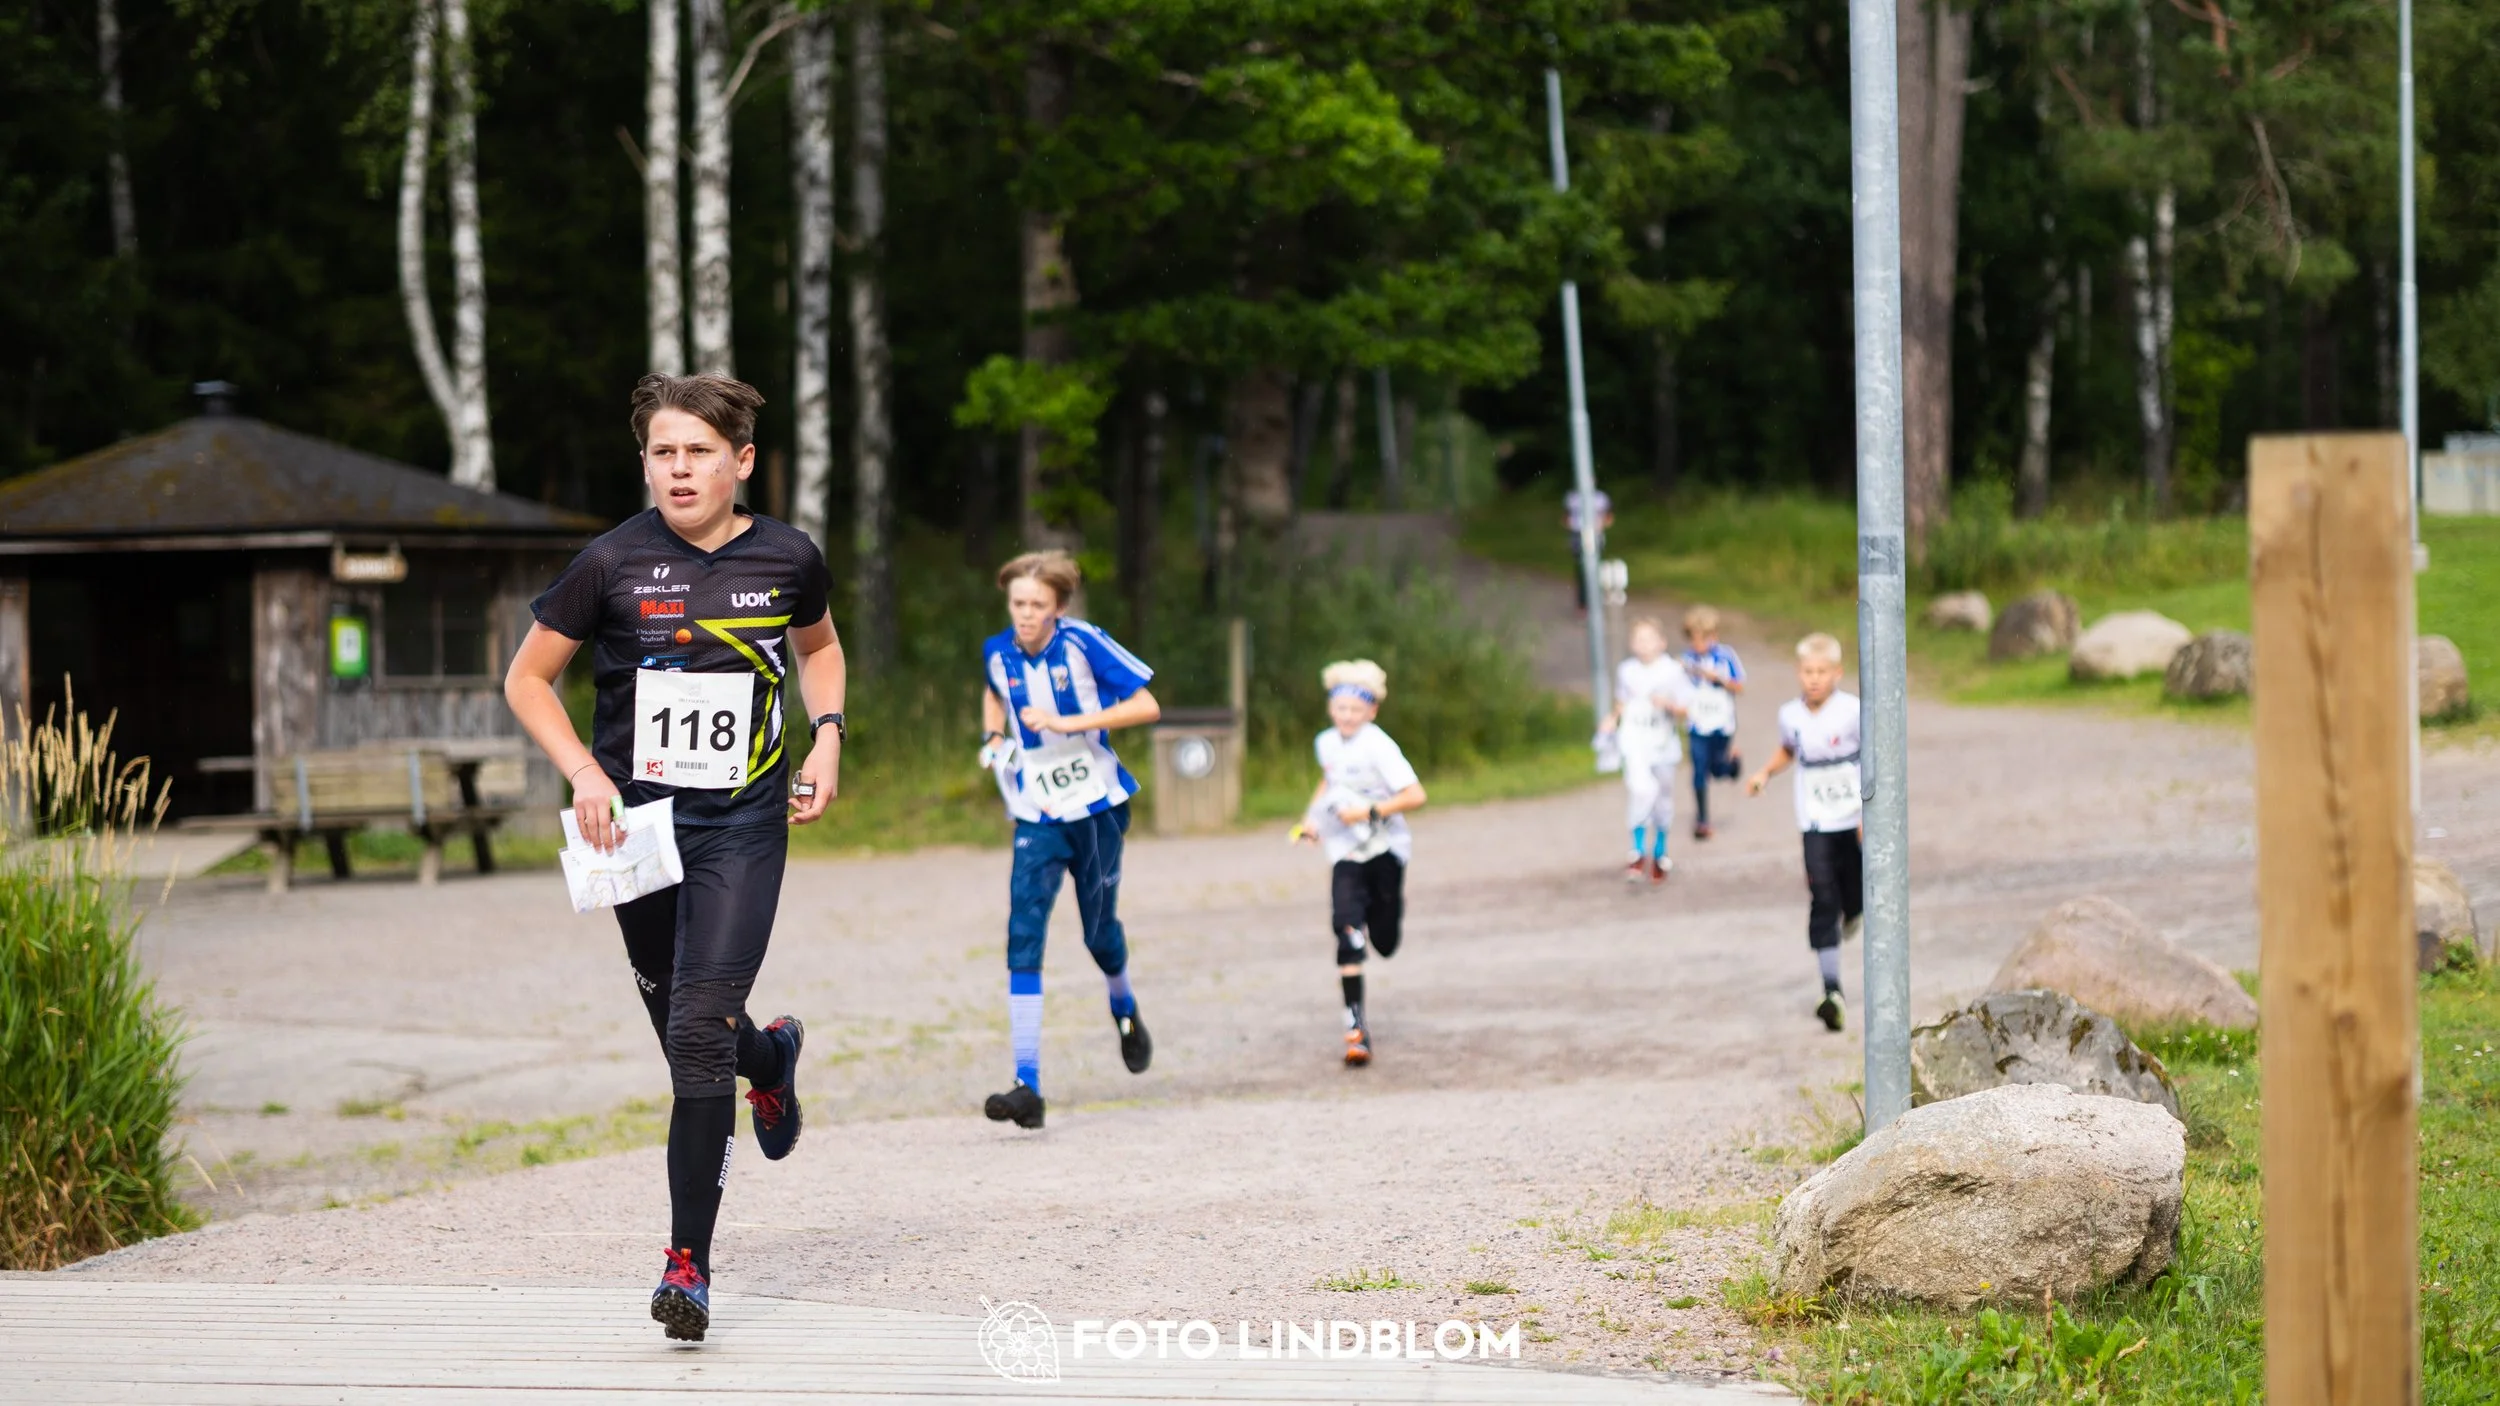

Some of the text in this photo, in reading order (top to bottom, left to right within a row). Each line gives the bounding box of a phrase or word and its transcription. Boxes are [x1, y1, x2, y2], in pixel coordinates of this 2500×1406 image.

[633, 584, 691, 594] ZEKLER
[731, 592, 772, 608] UOK
[651, 707, 736, 752] 118
[728, 766, 739, 781] 2
[1036, 757, 1090, 796] 165
